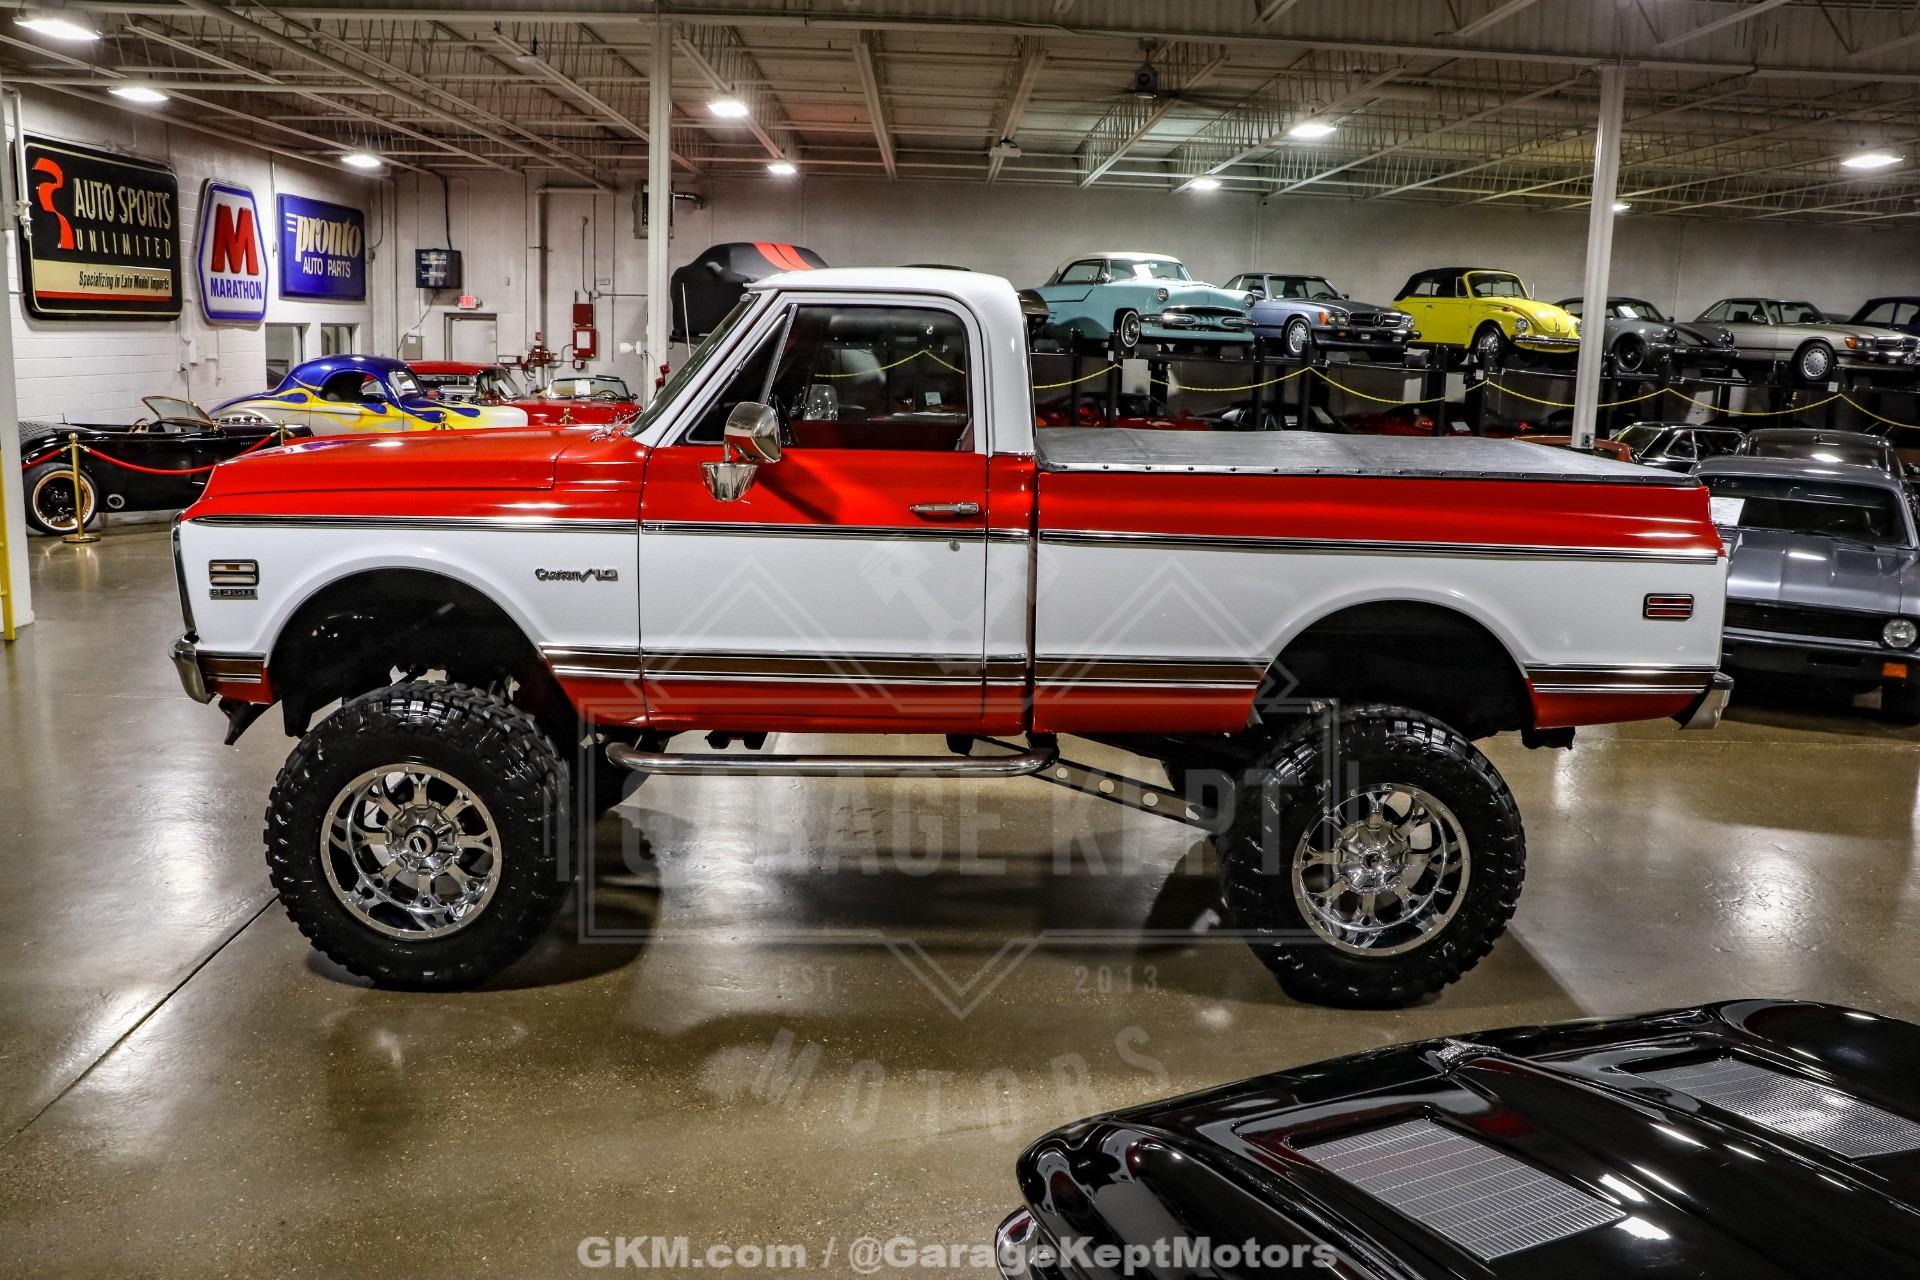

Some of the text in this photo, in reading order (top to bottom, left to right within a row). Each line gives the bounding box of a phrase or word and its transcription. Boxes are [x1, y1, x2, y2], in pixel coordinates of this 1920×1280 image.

[73, 178, 171, 229] AUTO SPORTS
[76, 228, 171, 259] UNLIMITED
[211, 203, 259, 275] M
[295, 214, 361, 262] pronto
[79, 270, 113, 290] Specializing
[114, 273, 120, 287] in
[303, 256, 351, 279] AUTO PARTS
[210, 278, 262, 299] MARATHON
